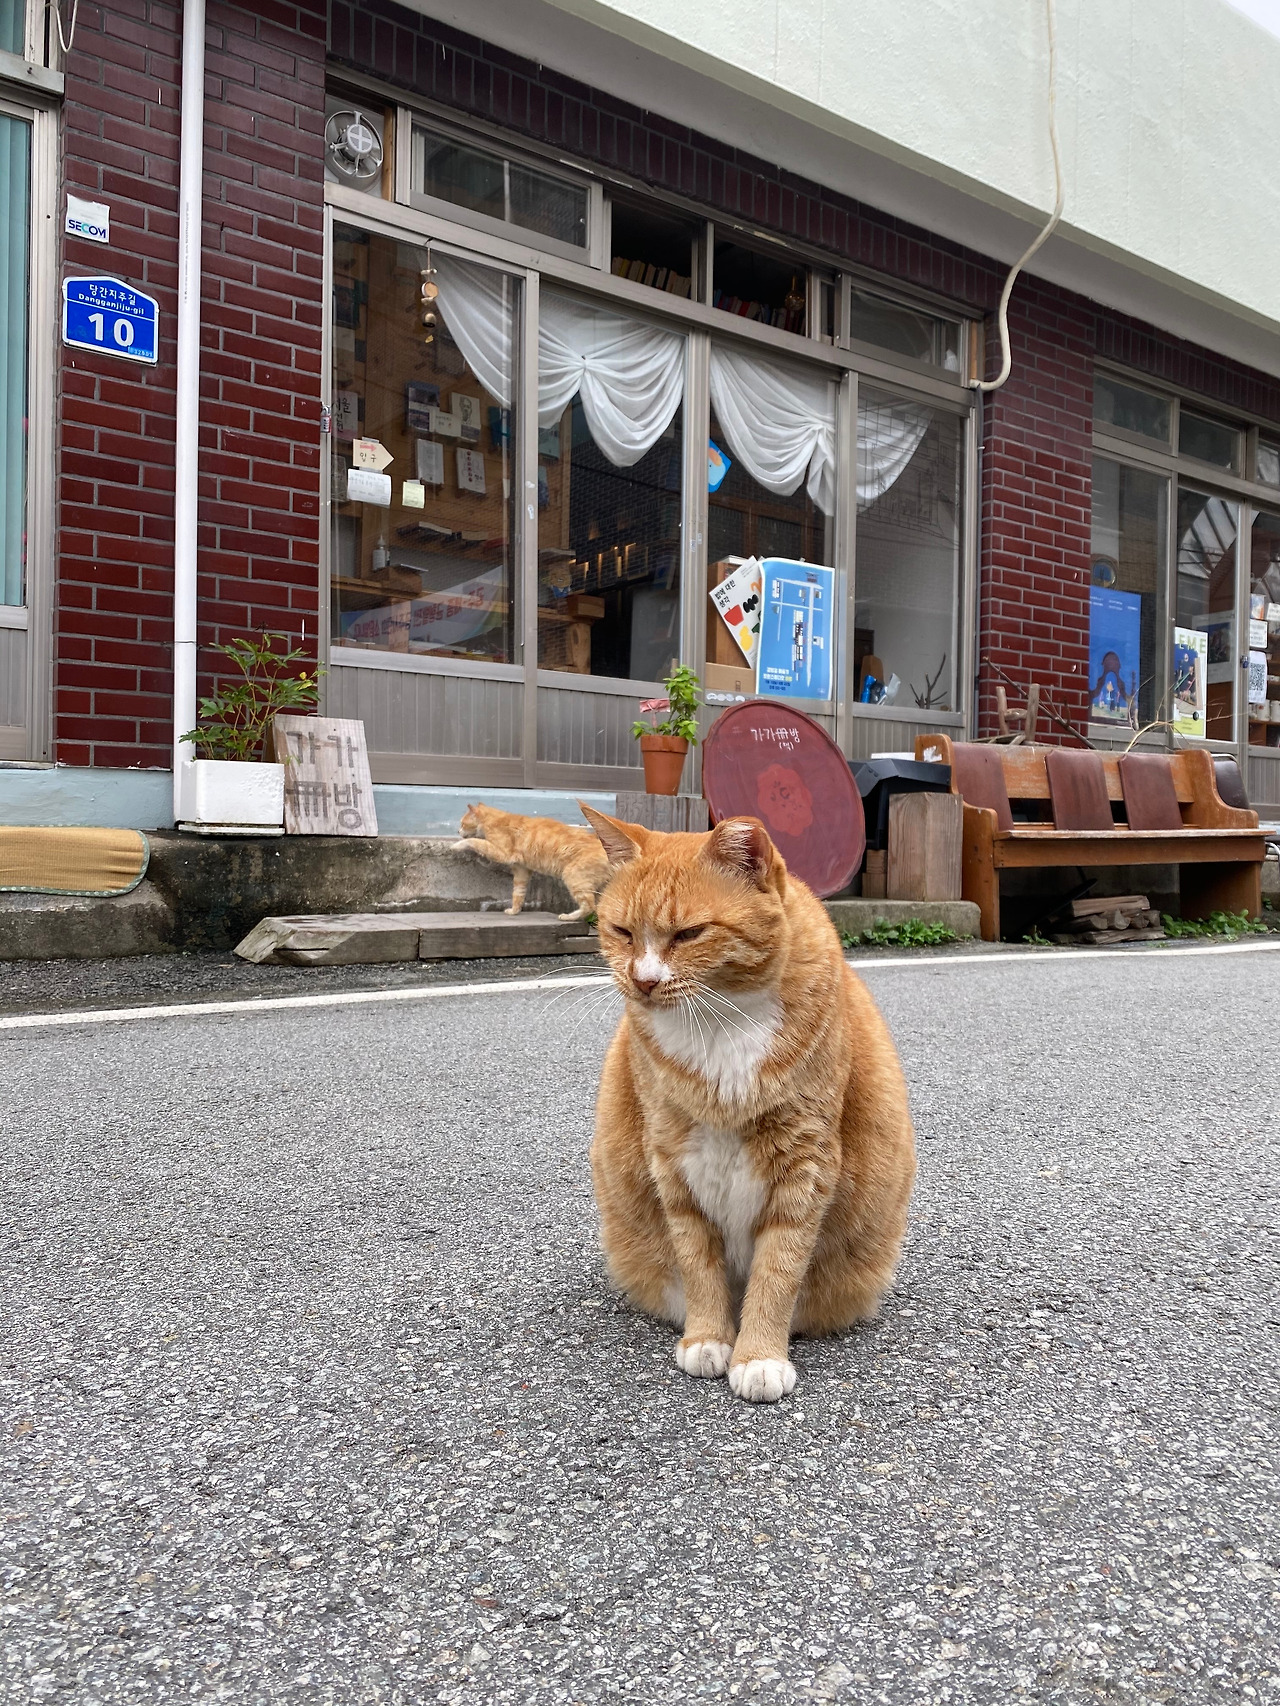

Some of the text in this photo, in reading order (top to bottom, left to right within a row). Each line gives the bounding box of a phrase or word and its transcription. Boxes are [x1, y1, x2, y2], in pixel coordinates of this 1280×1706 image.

[68, 219, 106, 239] SECOM
[78, 293, 145, 315] Dangganjiju-gil
[89, 284, 136, 306] 당간지주길
[87, 312, 135, 347] 10
[725, 579, 736, 591] 대한
[286, 731, 359, 768] 가가
